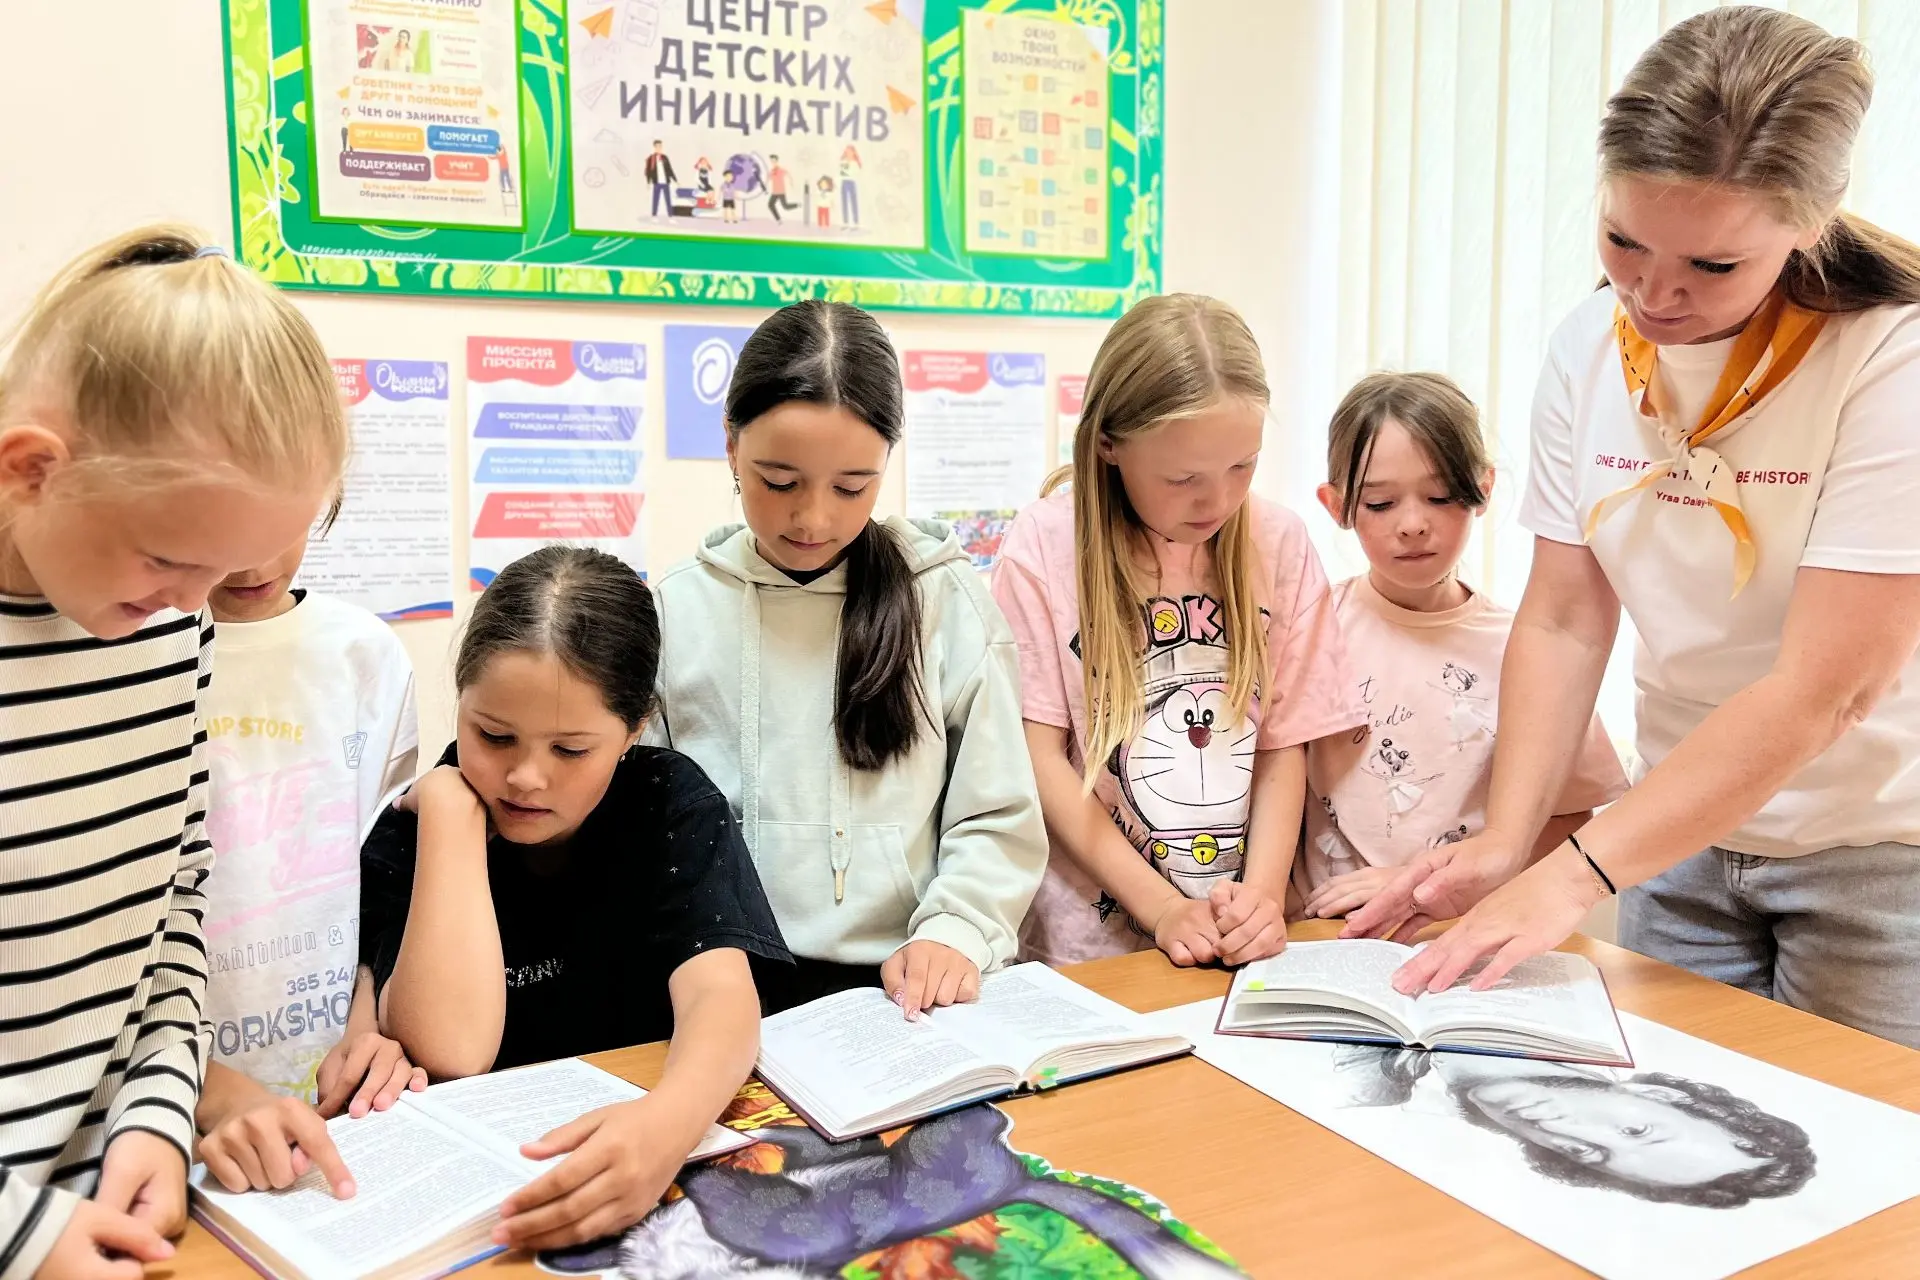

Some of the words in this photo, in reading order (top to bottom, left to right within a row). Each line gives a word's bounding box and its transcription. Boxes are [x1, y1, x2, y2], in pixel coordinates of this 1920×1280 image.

[687, 0, 829, 41] ЦЕНТР
[1024, 26, 1057, 41] ОКНО
[1020, 40, 1059, 57] ТВОИХ
[655, 37, 856, 95] ДЕТСКИХ
[992, 51, 1086, 73] ВОЗМОЖНОСТЕЙ
[360, 90, 392, 102] ДРУГ
[429, 82, 450, 94] ЭТО
[454, 84, 484, 97] ТВОЙ
[386, 109, 402, 120] ОН
[619, 80, 890, 142] ИНИЦИАТИВ
[439, 130, 489, 143] ПОМОГАЕТ
[345, 158, 426, 172] ПОДДЕРЖИВАЕТ
[449, 160, 475, 171] УЧИТ
[485, 345, 553, 358] МИССИЯ
[482, 356, 557, 370] ПРОЕКТА
[497, 412, 560, 421] ВОСПИТАНИЕ
[510, 422, 555, 432] ГРАЖДАН
[1595, 454, 1615, 468] ONE
[1618, 458, 1639, 471] DAY
[1736, 471, 1750, 483] BE
[206, 717, 234, 737] UP
[238, 717, 305, 744] STORE
[328, 925, 343, 946] &
[286, 973, 320, 996] 365
[211, 991, 351, 1057] ORKSHO
